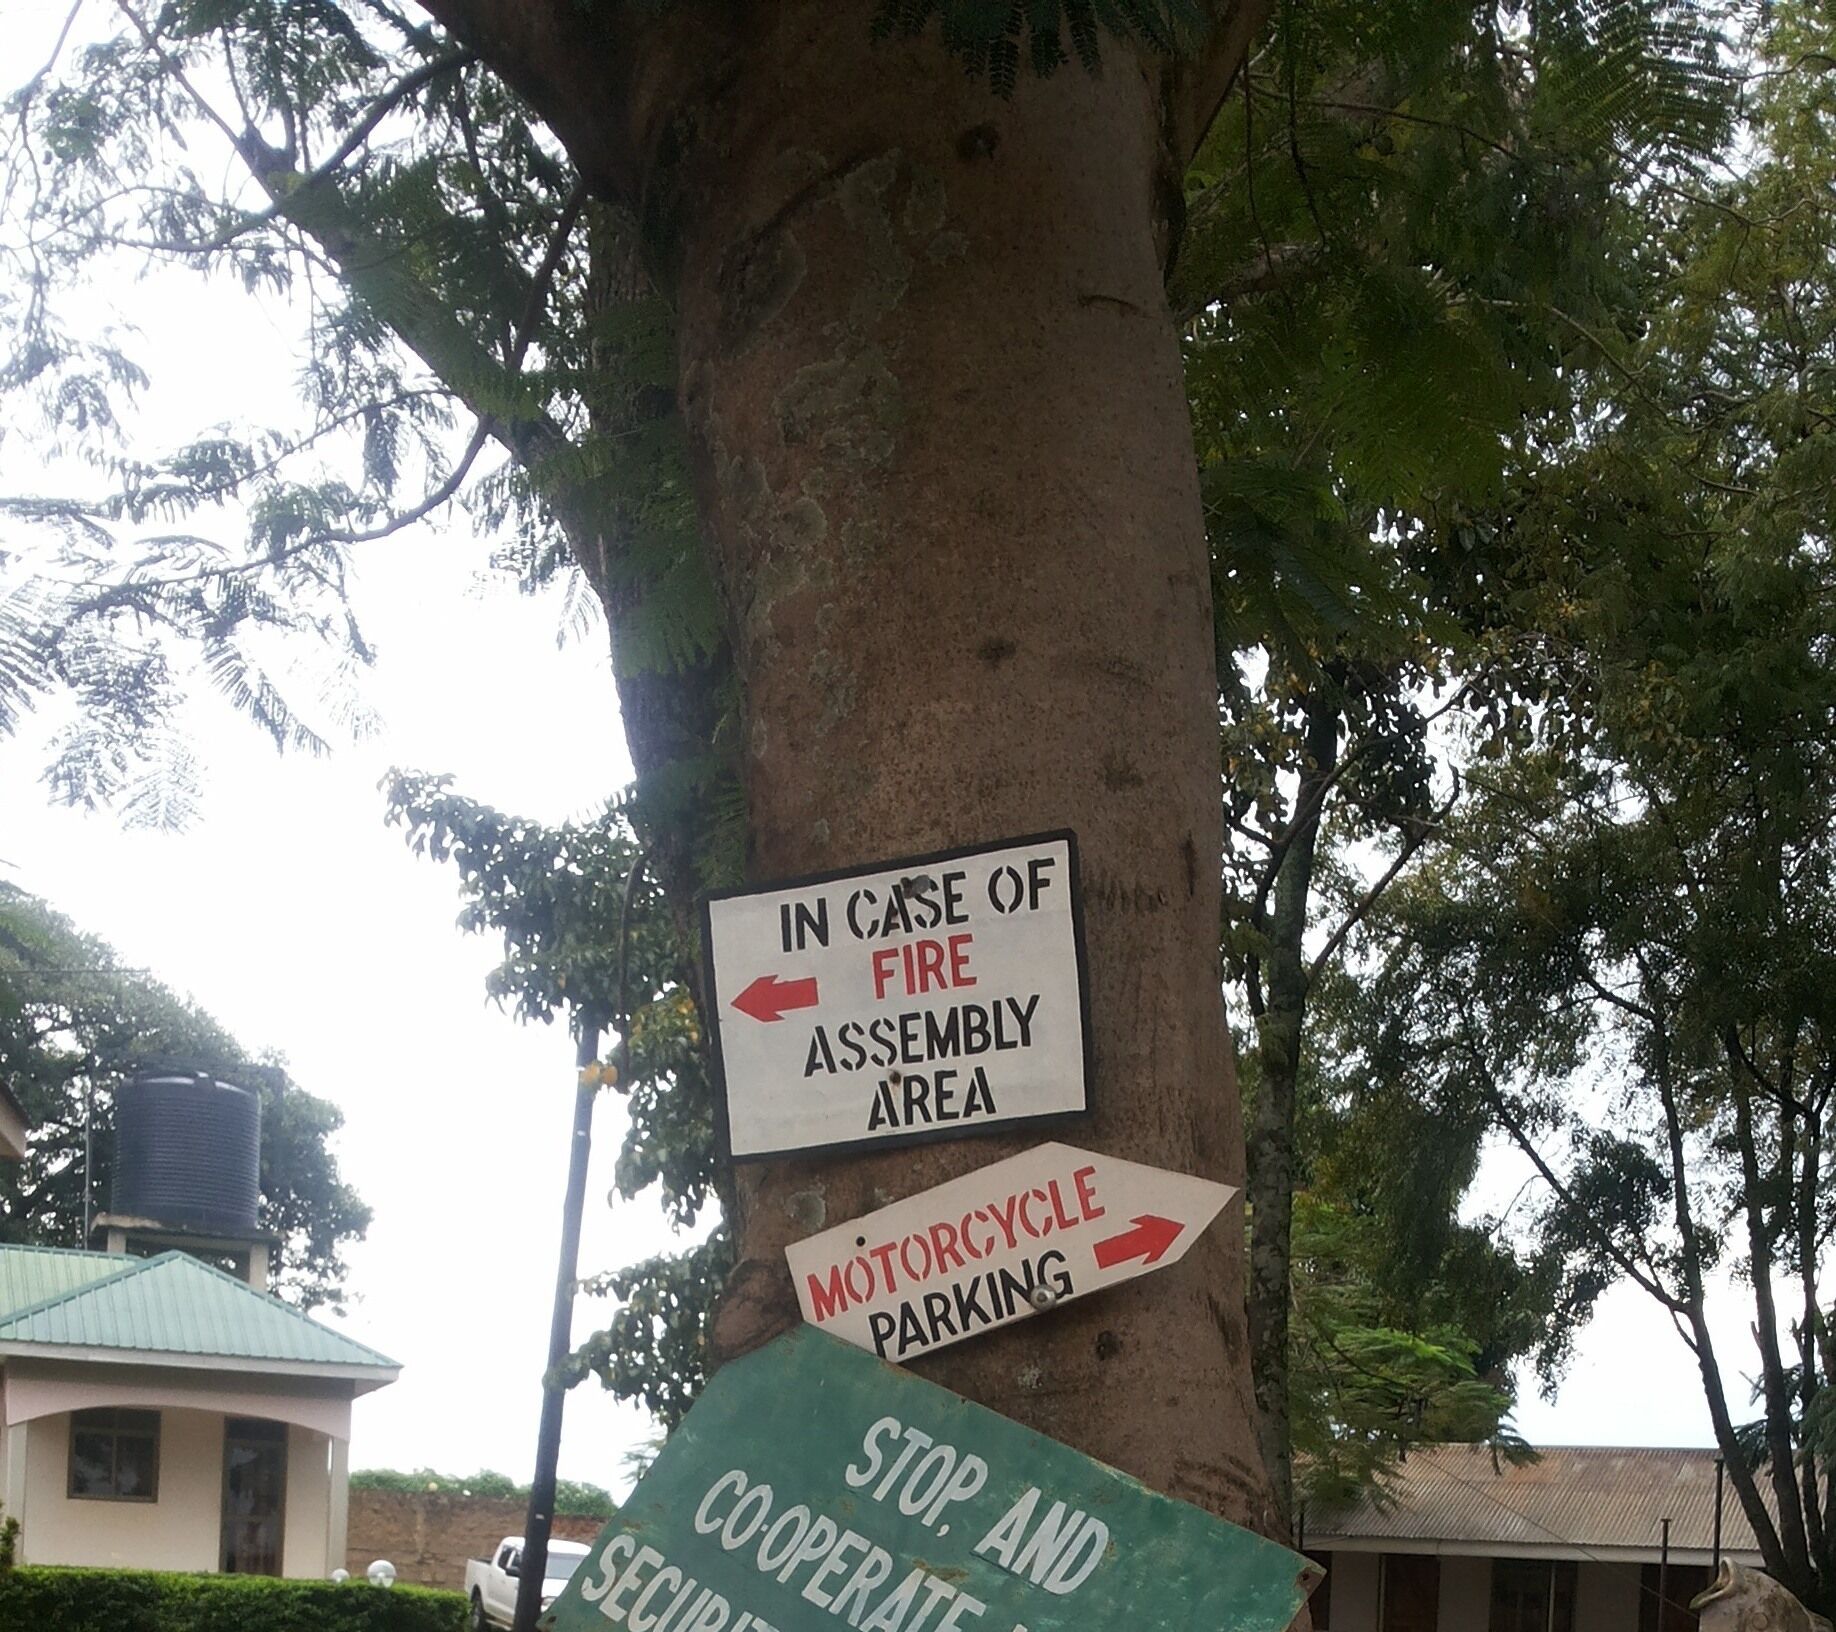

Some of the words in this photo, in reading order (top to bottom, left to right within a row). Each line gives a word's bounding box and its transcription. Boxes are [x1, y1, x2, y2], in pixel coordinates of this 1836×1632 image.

[780, 898, 829, 953] IN
[846, 871, 969, 939] CASE
[988, 858, 1055, 914] OF
[872, 933, 977, 1000] FIRE
[804, 994, 1040, 1078] ASSEMBLY
[867, 1067, 996, 1131] AREA
[807, 1166, 1105, 1322] MOTORCYCLE
[868, 1250, 1073, 1358] PARKING
[975, 1487, 1109, 1596] AND
